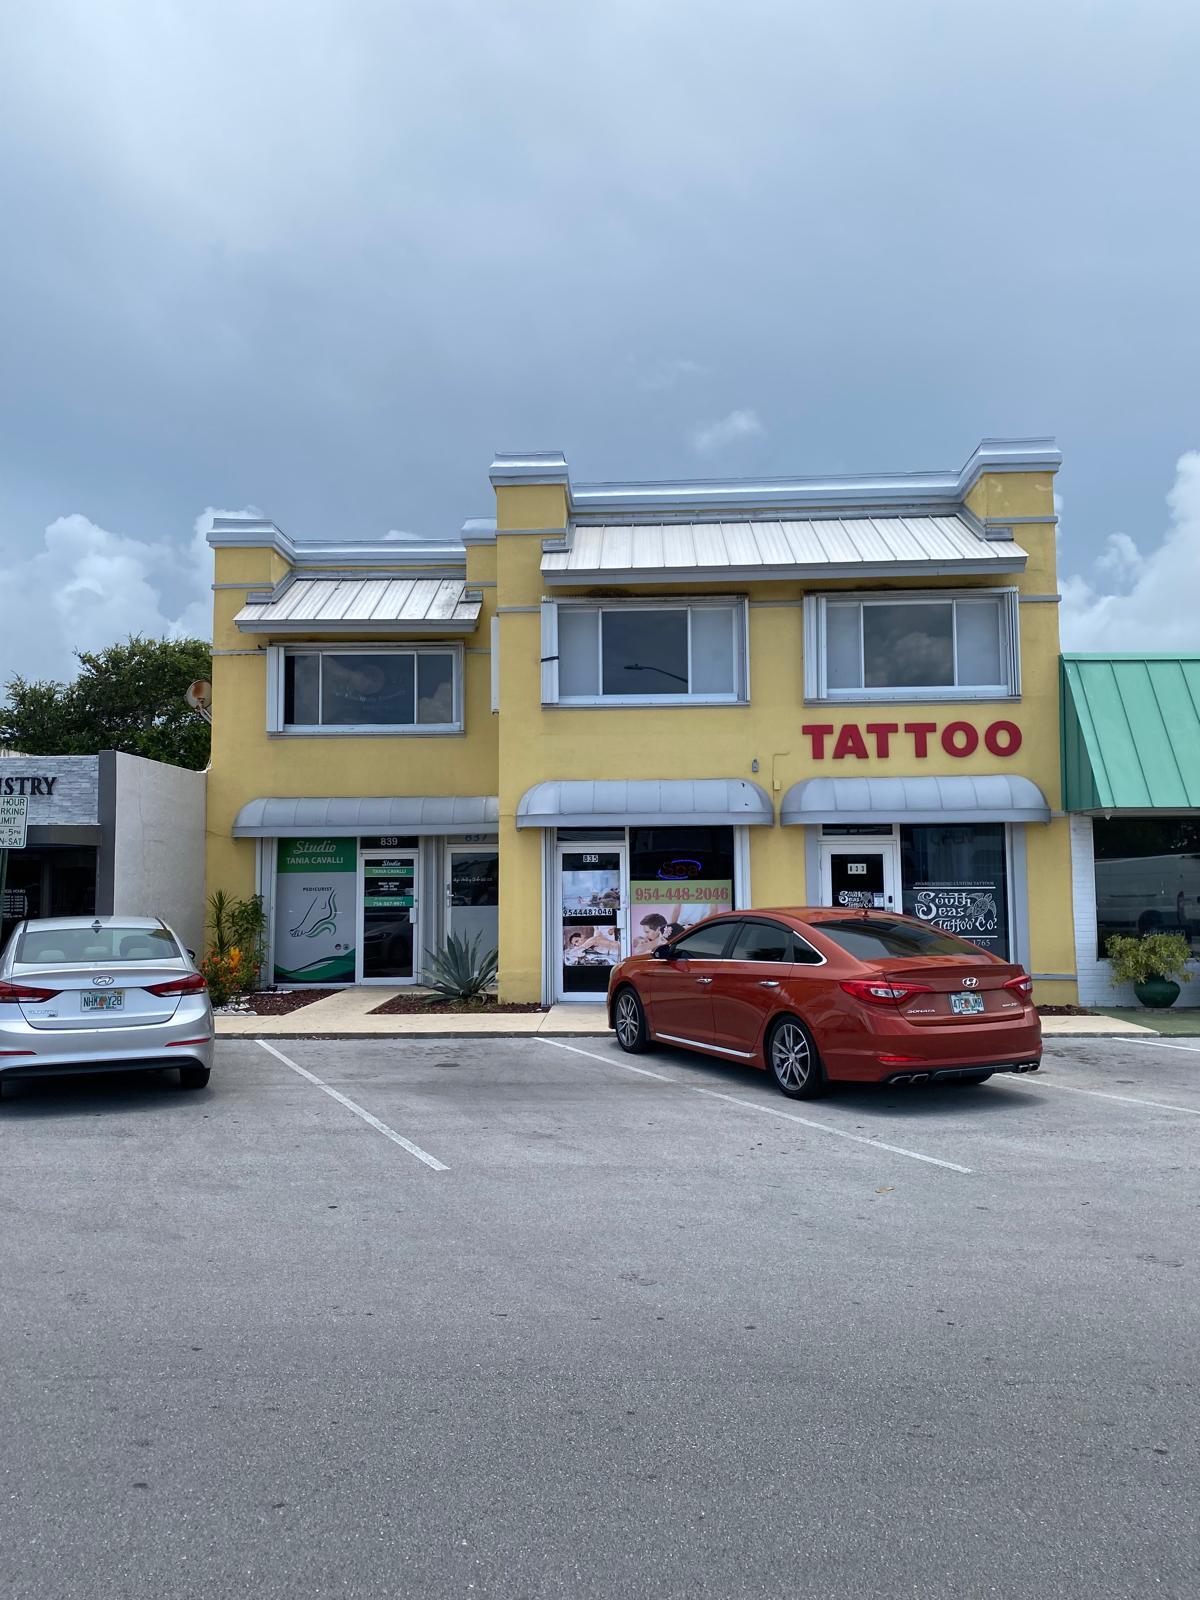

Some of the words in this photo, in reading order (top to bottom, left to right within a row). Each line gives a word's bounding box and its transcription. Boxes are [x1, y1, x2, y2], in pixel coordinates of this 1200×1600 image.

[802, 721, 1023, 760] TATTOO
[2, 798, 25, 806] HOUR
[293, 840, 336, 854] Studio
[380, 837, 398, 846] 839
[635, 887, 729, 901] 954-448-2046
